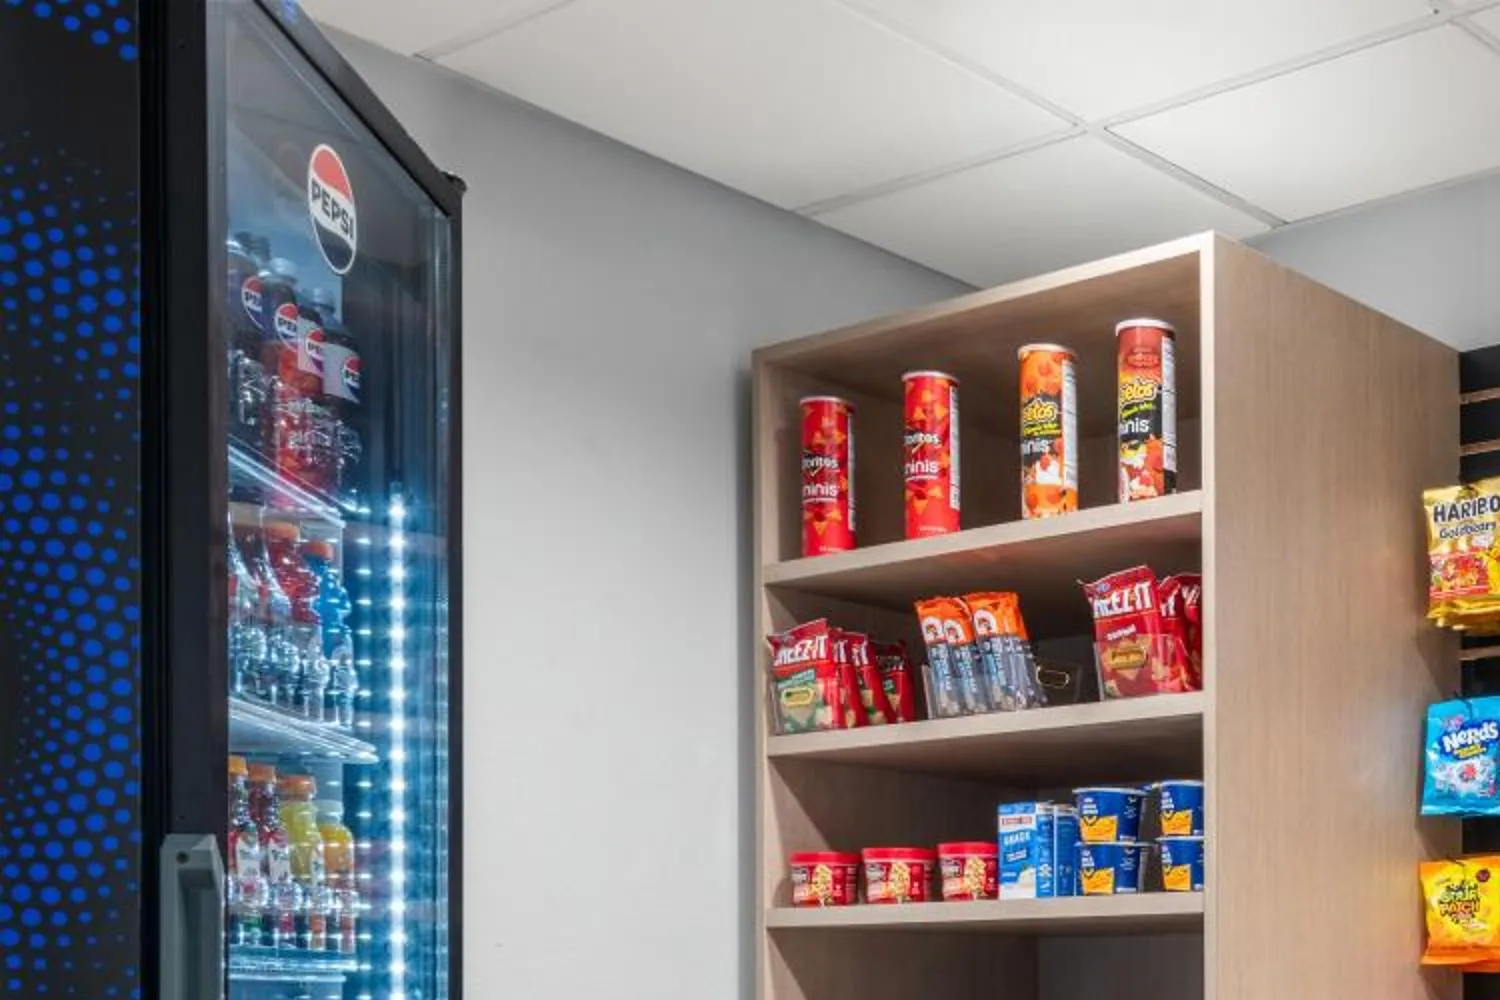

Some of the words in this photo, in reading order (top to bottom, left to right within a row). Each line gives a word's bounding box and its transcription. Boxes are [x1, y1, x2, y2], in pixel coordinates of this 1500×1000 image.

[310, 184, 356, 240] PEPSI
[1433, 494, 1500, 523] HARIBO
[1439, 520, 1497, 540] Goldbears
[1441, 719, 1500, 753] Nerds
